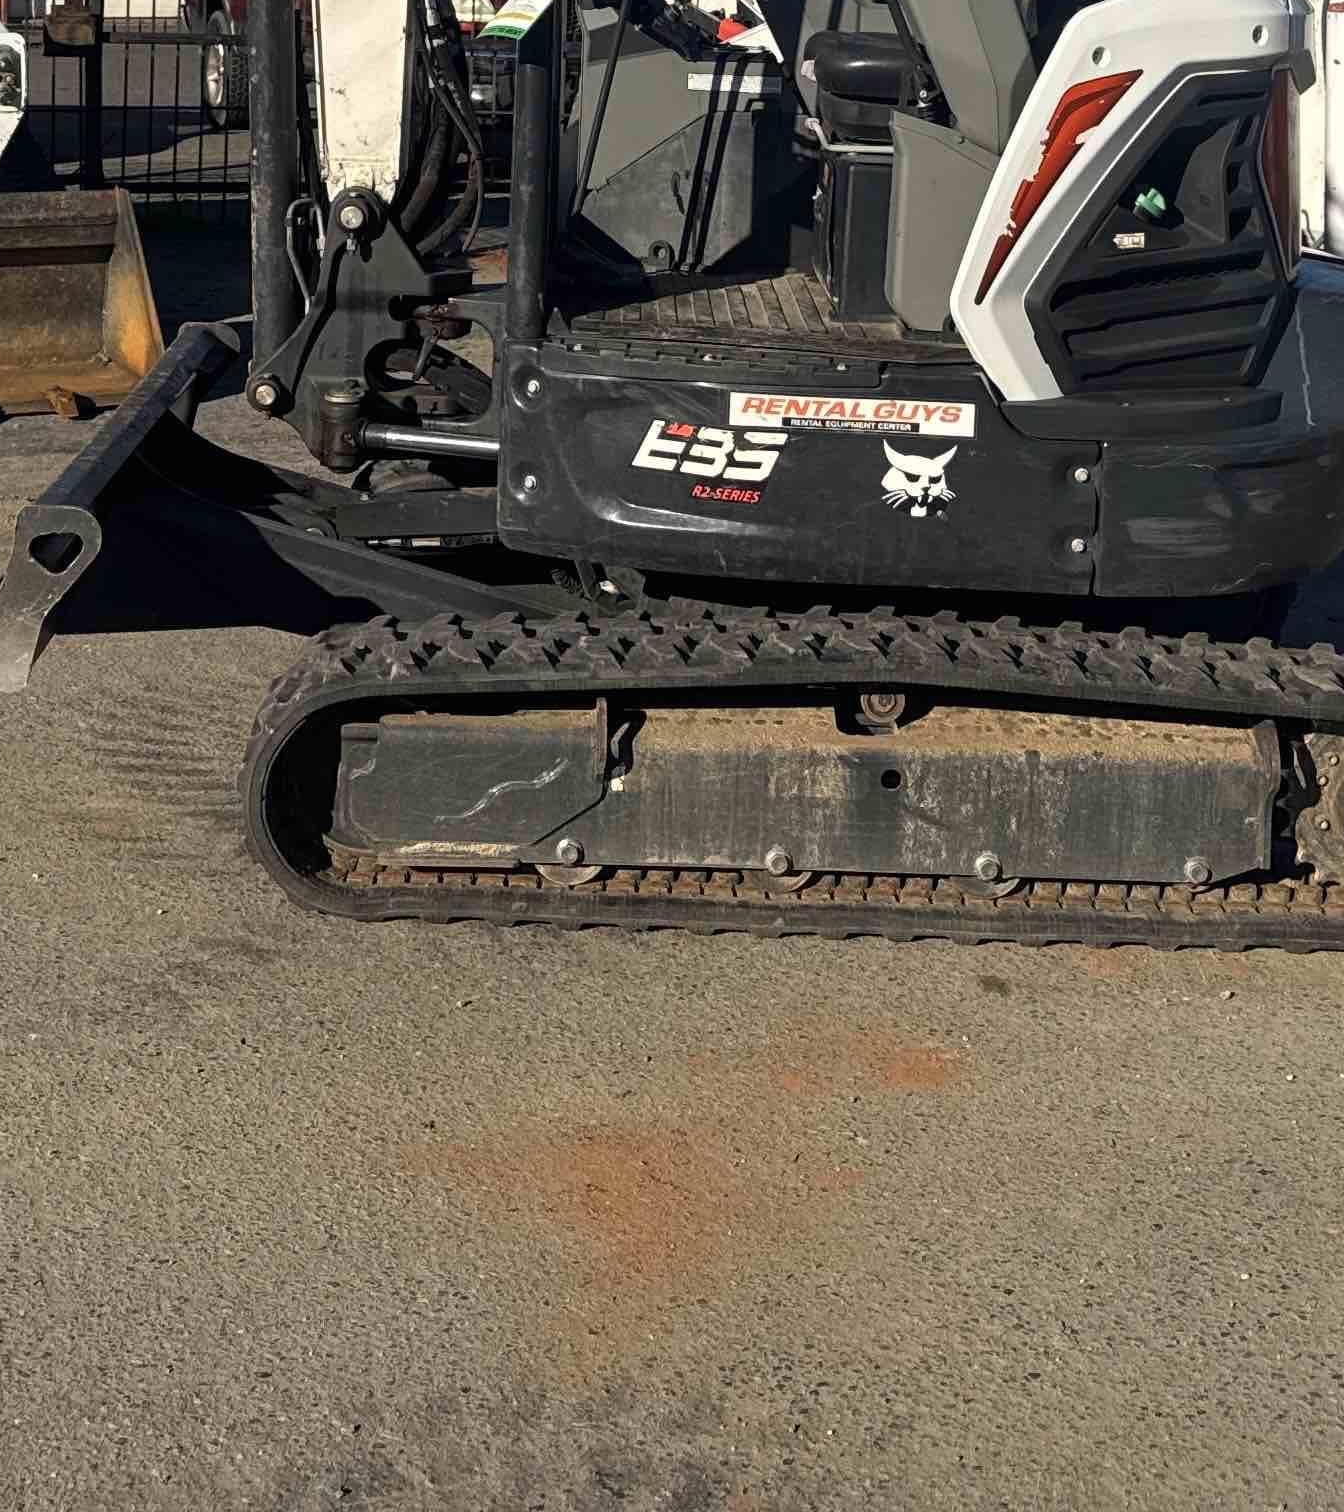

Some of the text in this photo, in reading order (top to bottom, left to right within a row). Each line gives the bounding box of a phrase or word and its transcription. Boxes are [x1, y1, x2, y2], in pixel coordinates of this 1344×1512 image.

[741, 397, 963, 423] RENTAL GUYS
[790, 419, 912, 432] RENTAL EQUIPMENT CENTER
[692, 485, 761, 504] R2-SERIES
